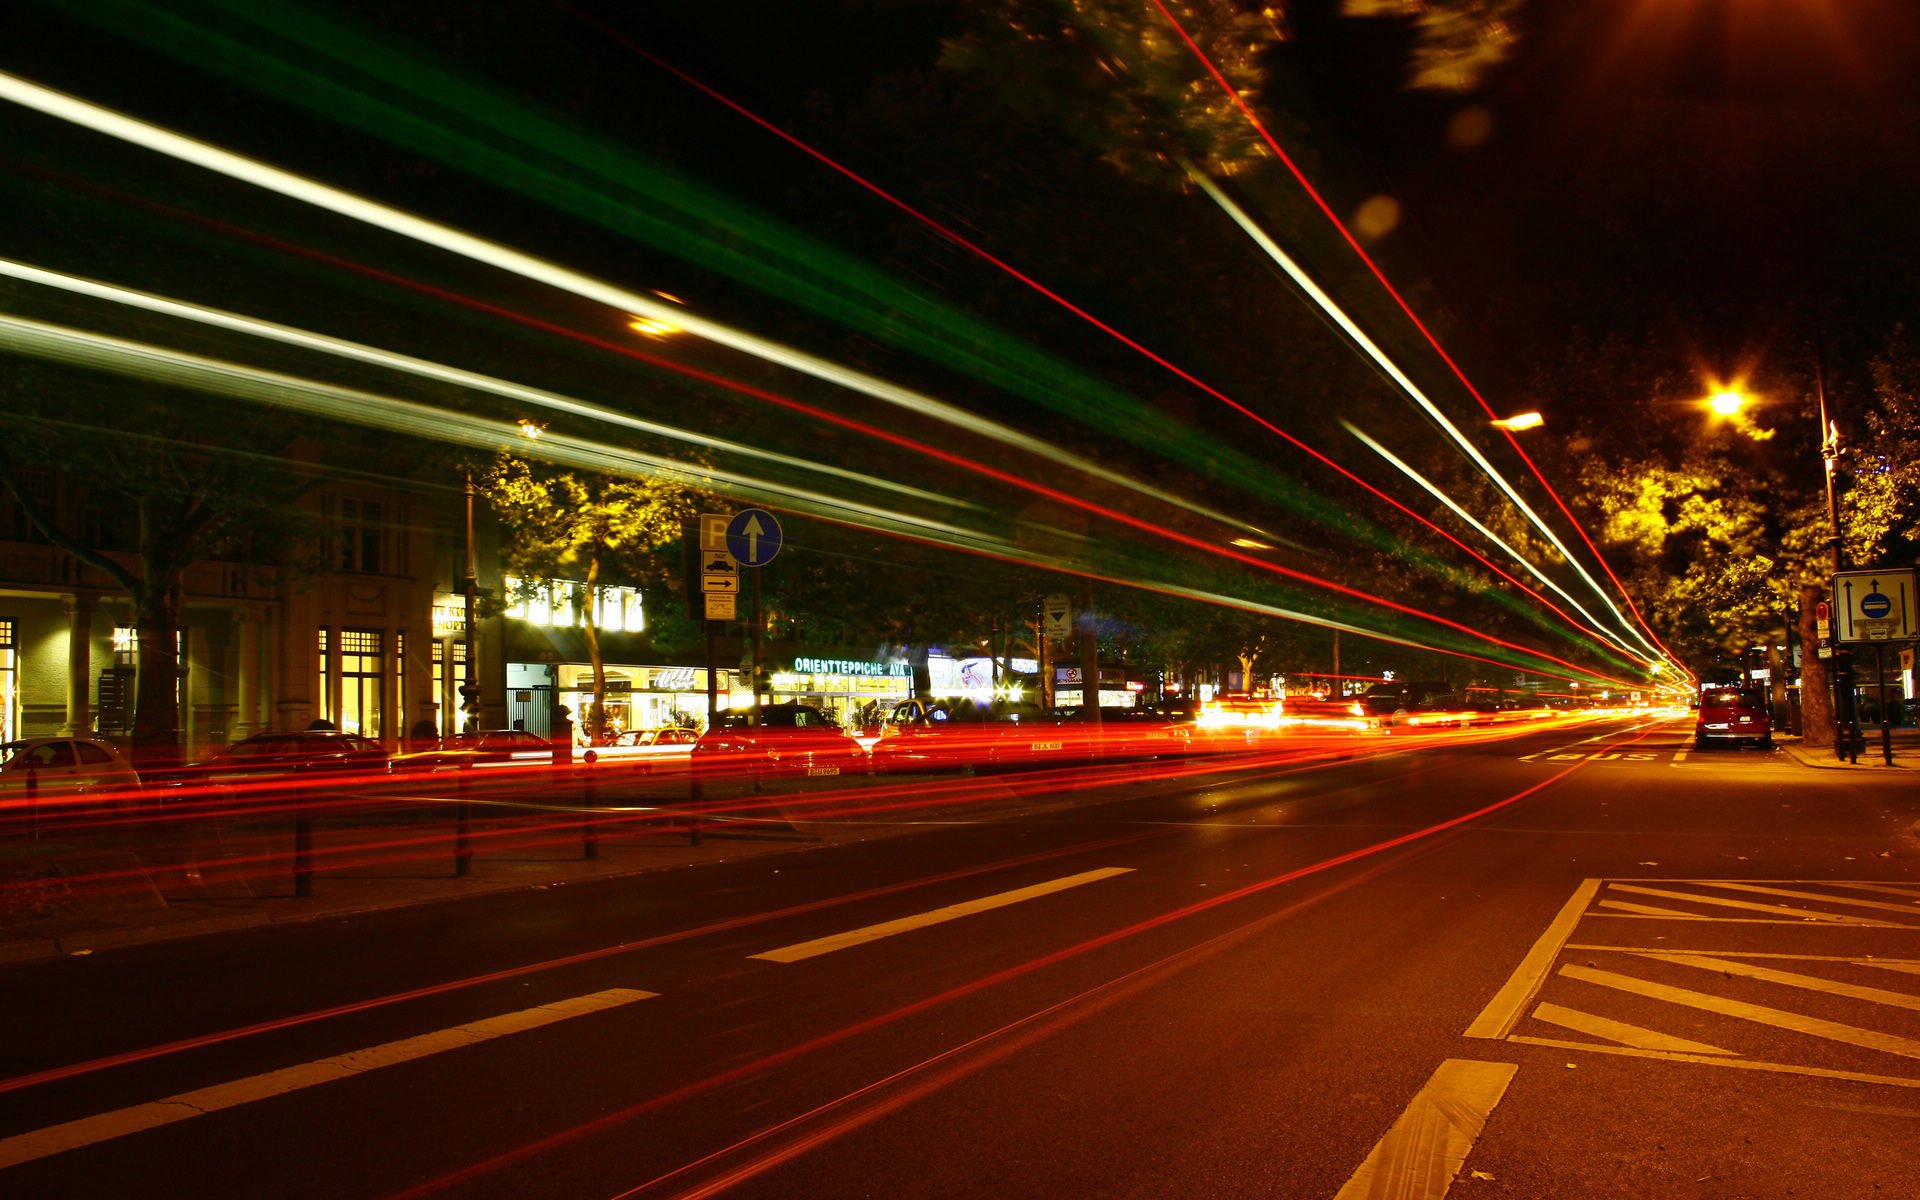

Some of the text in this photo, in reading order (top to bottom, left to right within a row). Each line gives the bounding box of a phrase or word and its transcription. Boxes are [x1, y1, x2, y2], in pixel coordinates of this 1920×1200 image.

[709, 519, 728, 547] P
[794, 657, 906, 676] ORIENTTEPPICHE AYA
[1546, 753, 1659, 761] BUS
